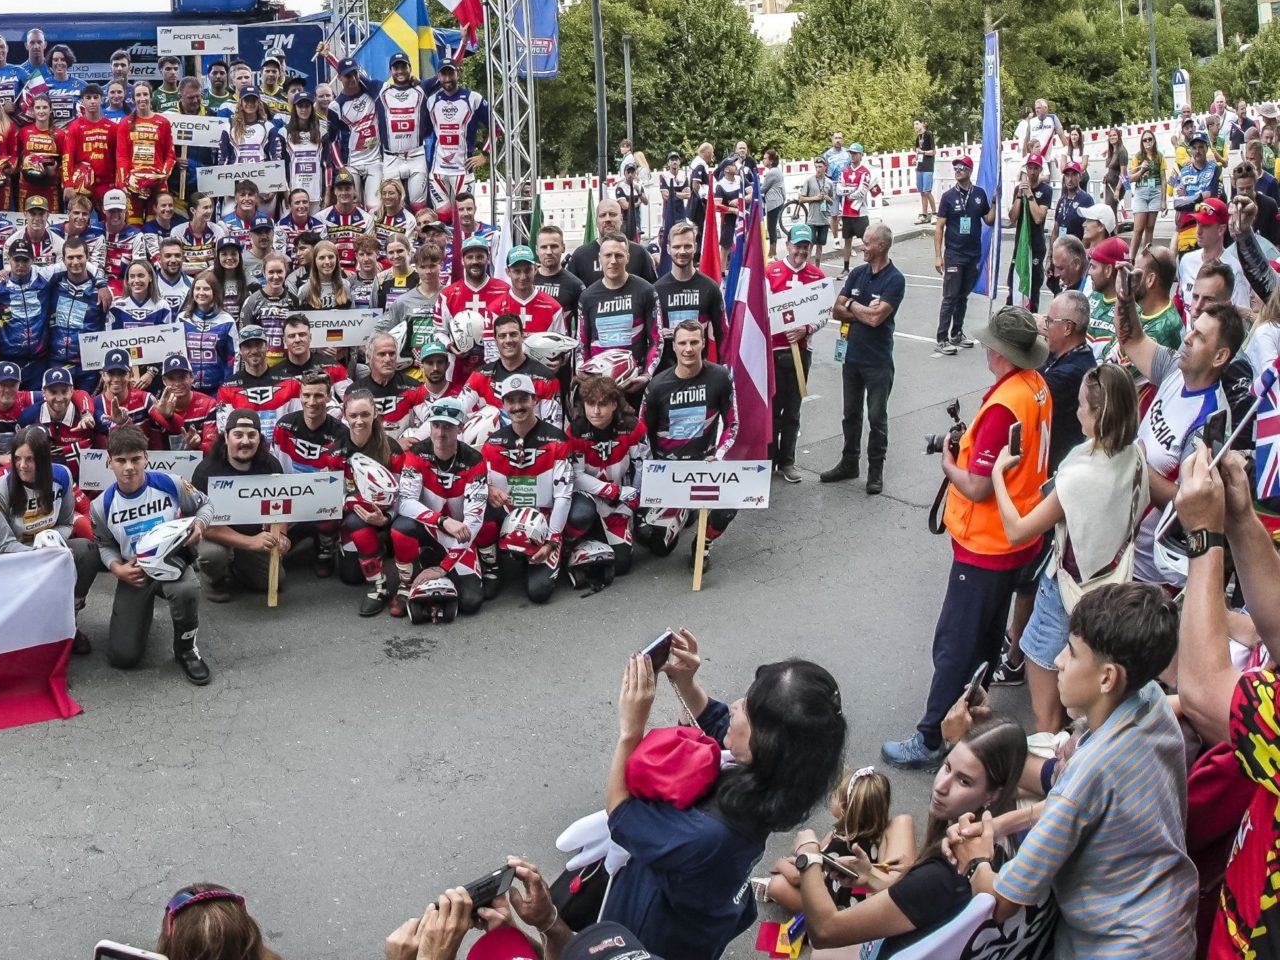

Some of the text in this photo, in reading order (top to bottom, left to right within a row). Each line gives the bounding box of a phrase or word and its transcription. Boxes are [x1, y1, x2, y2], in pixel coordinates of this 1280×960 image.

[259, 34, 295, 50] FIM
[171, 121, 210, 131] WEDEN
[397, 121, 410, 130] 10
[217, 169, 266, 181] FRANCE
[597, 297, 632, 313] LATVIA
[667, 292, 700, 307] LATVIA
[768, 293, 819, 314] ITZERLAND
[82, 335, 99, 343] FIM
[101, 335, 166, 349] ANDORRA
[670, 388, 707, 405] LATVIA
[84, 452, 103, 461] FIM
[646, 464, 667, 473] FIM
[671, 472, 740, 484] LATVIA
[211, 479, 234, 490] FIM
[238, 485, 315, 499] CANADA
[111, 496, 173, 525] CZECHIA
[212, 514, 232, 522] Hertz
